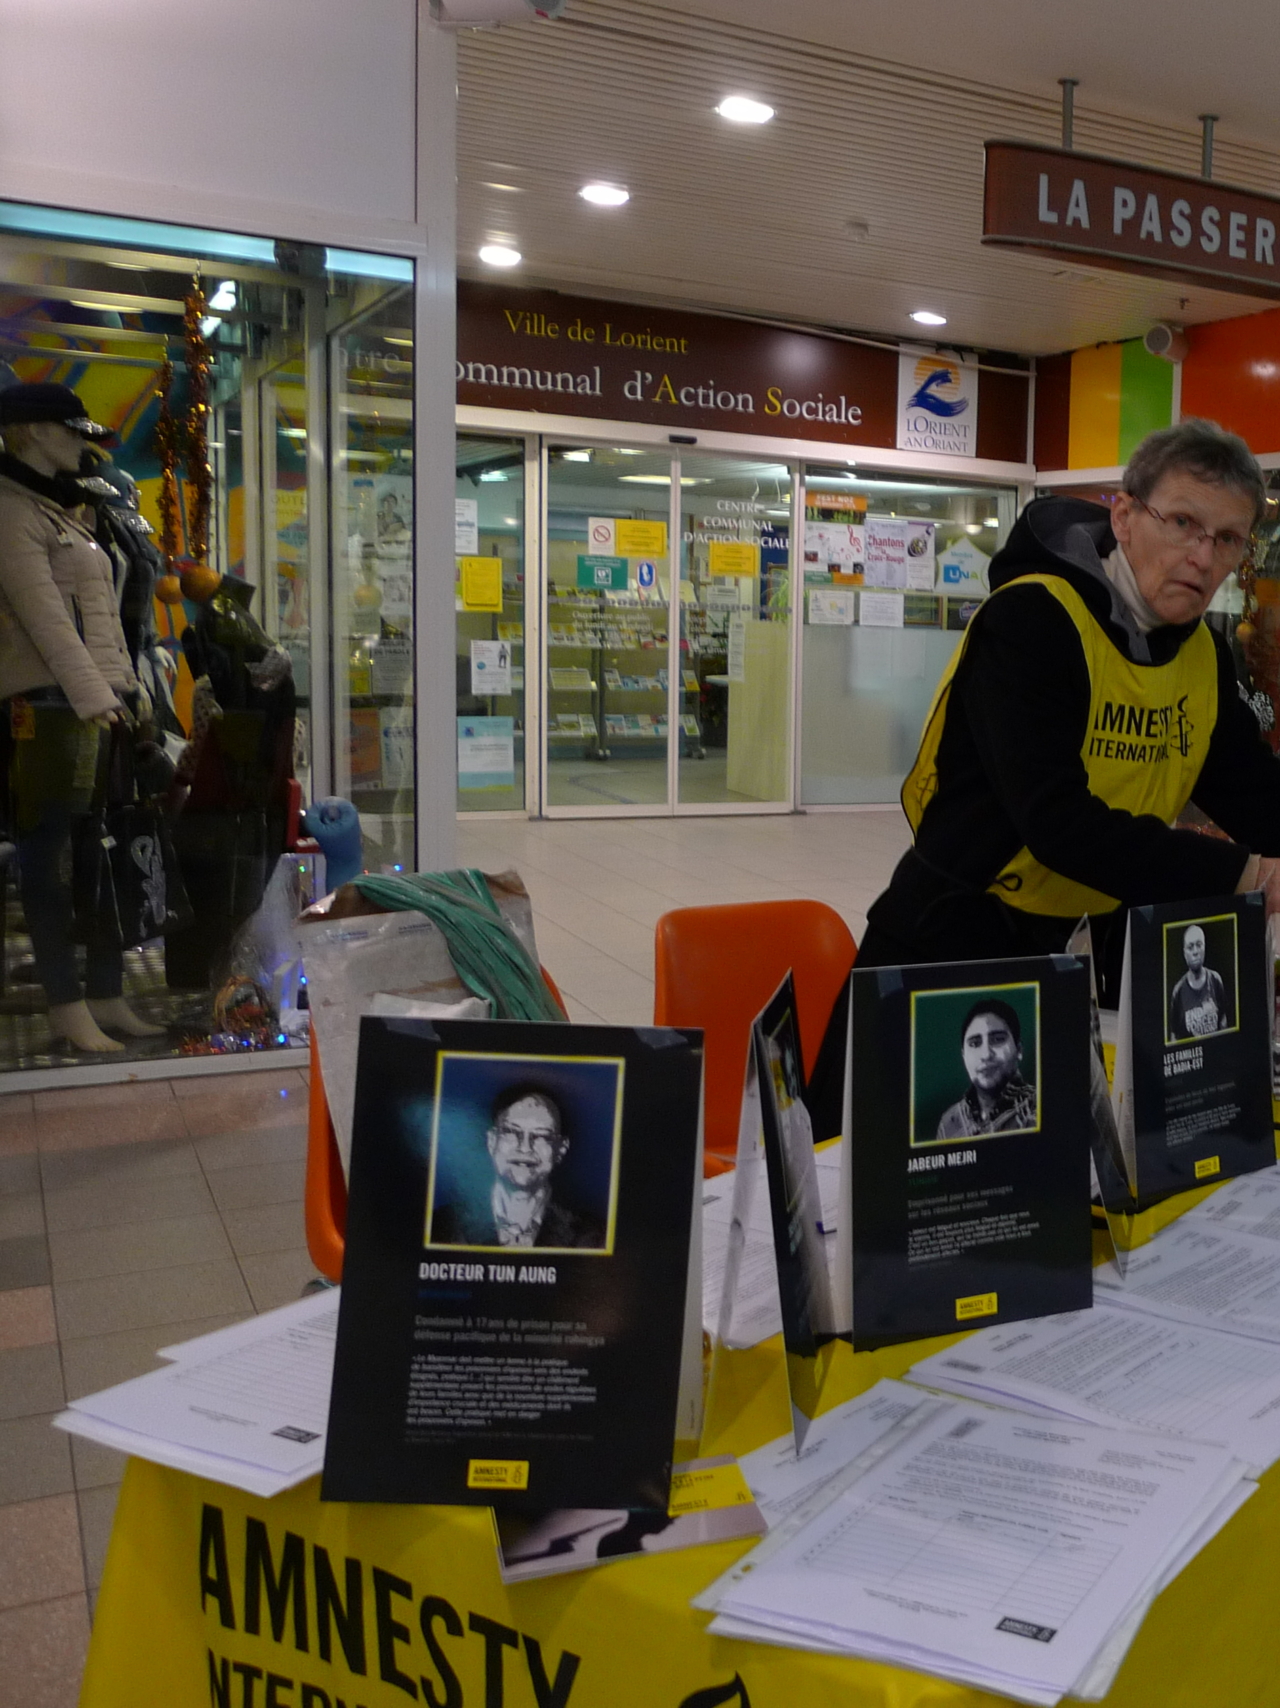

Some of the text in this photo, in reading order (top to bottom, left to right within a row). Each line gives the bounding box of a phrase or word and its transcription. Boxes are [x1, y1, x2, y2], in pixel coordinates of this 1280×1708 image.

[1037, 172, 1091, 230] LA
[503, 309, 690, 354] Ville de Lorient
[622, 369, 755, 415] d'Action
[763, 385, 863, 426] Sociale
[906, 415, 971, 440] LORIENT
[703, 515, 774, 533] COMMUNAL
[868, 534, 905, 549] Chantons
[949, 565, 980, 582] UNA
[1163, 1046, 1203, 1065] LES FAMILLES
[907, 1149, 978, 1174] JABEUR MEJRI
[418, 1261, 557, 1285] DOCTEUR TUN AUNG
[473, 1464, 508, 1476] AMNESTY
[199, 1500, 582, 1708] AMNESTY
